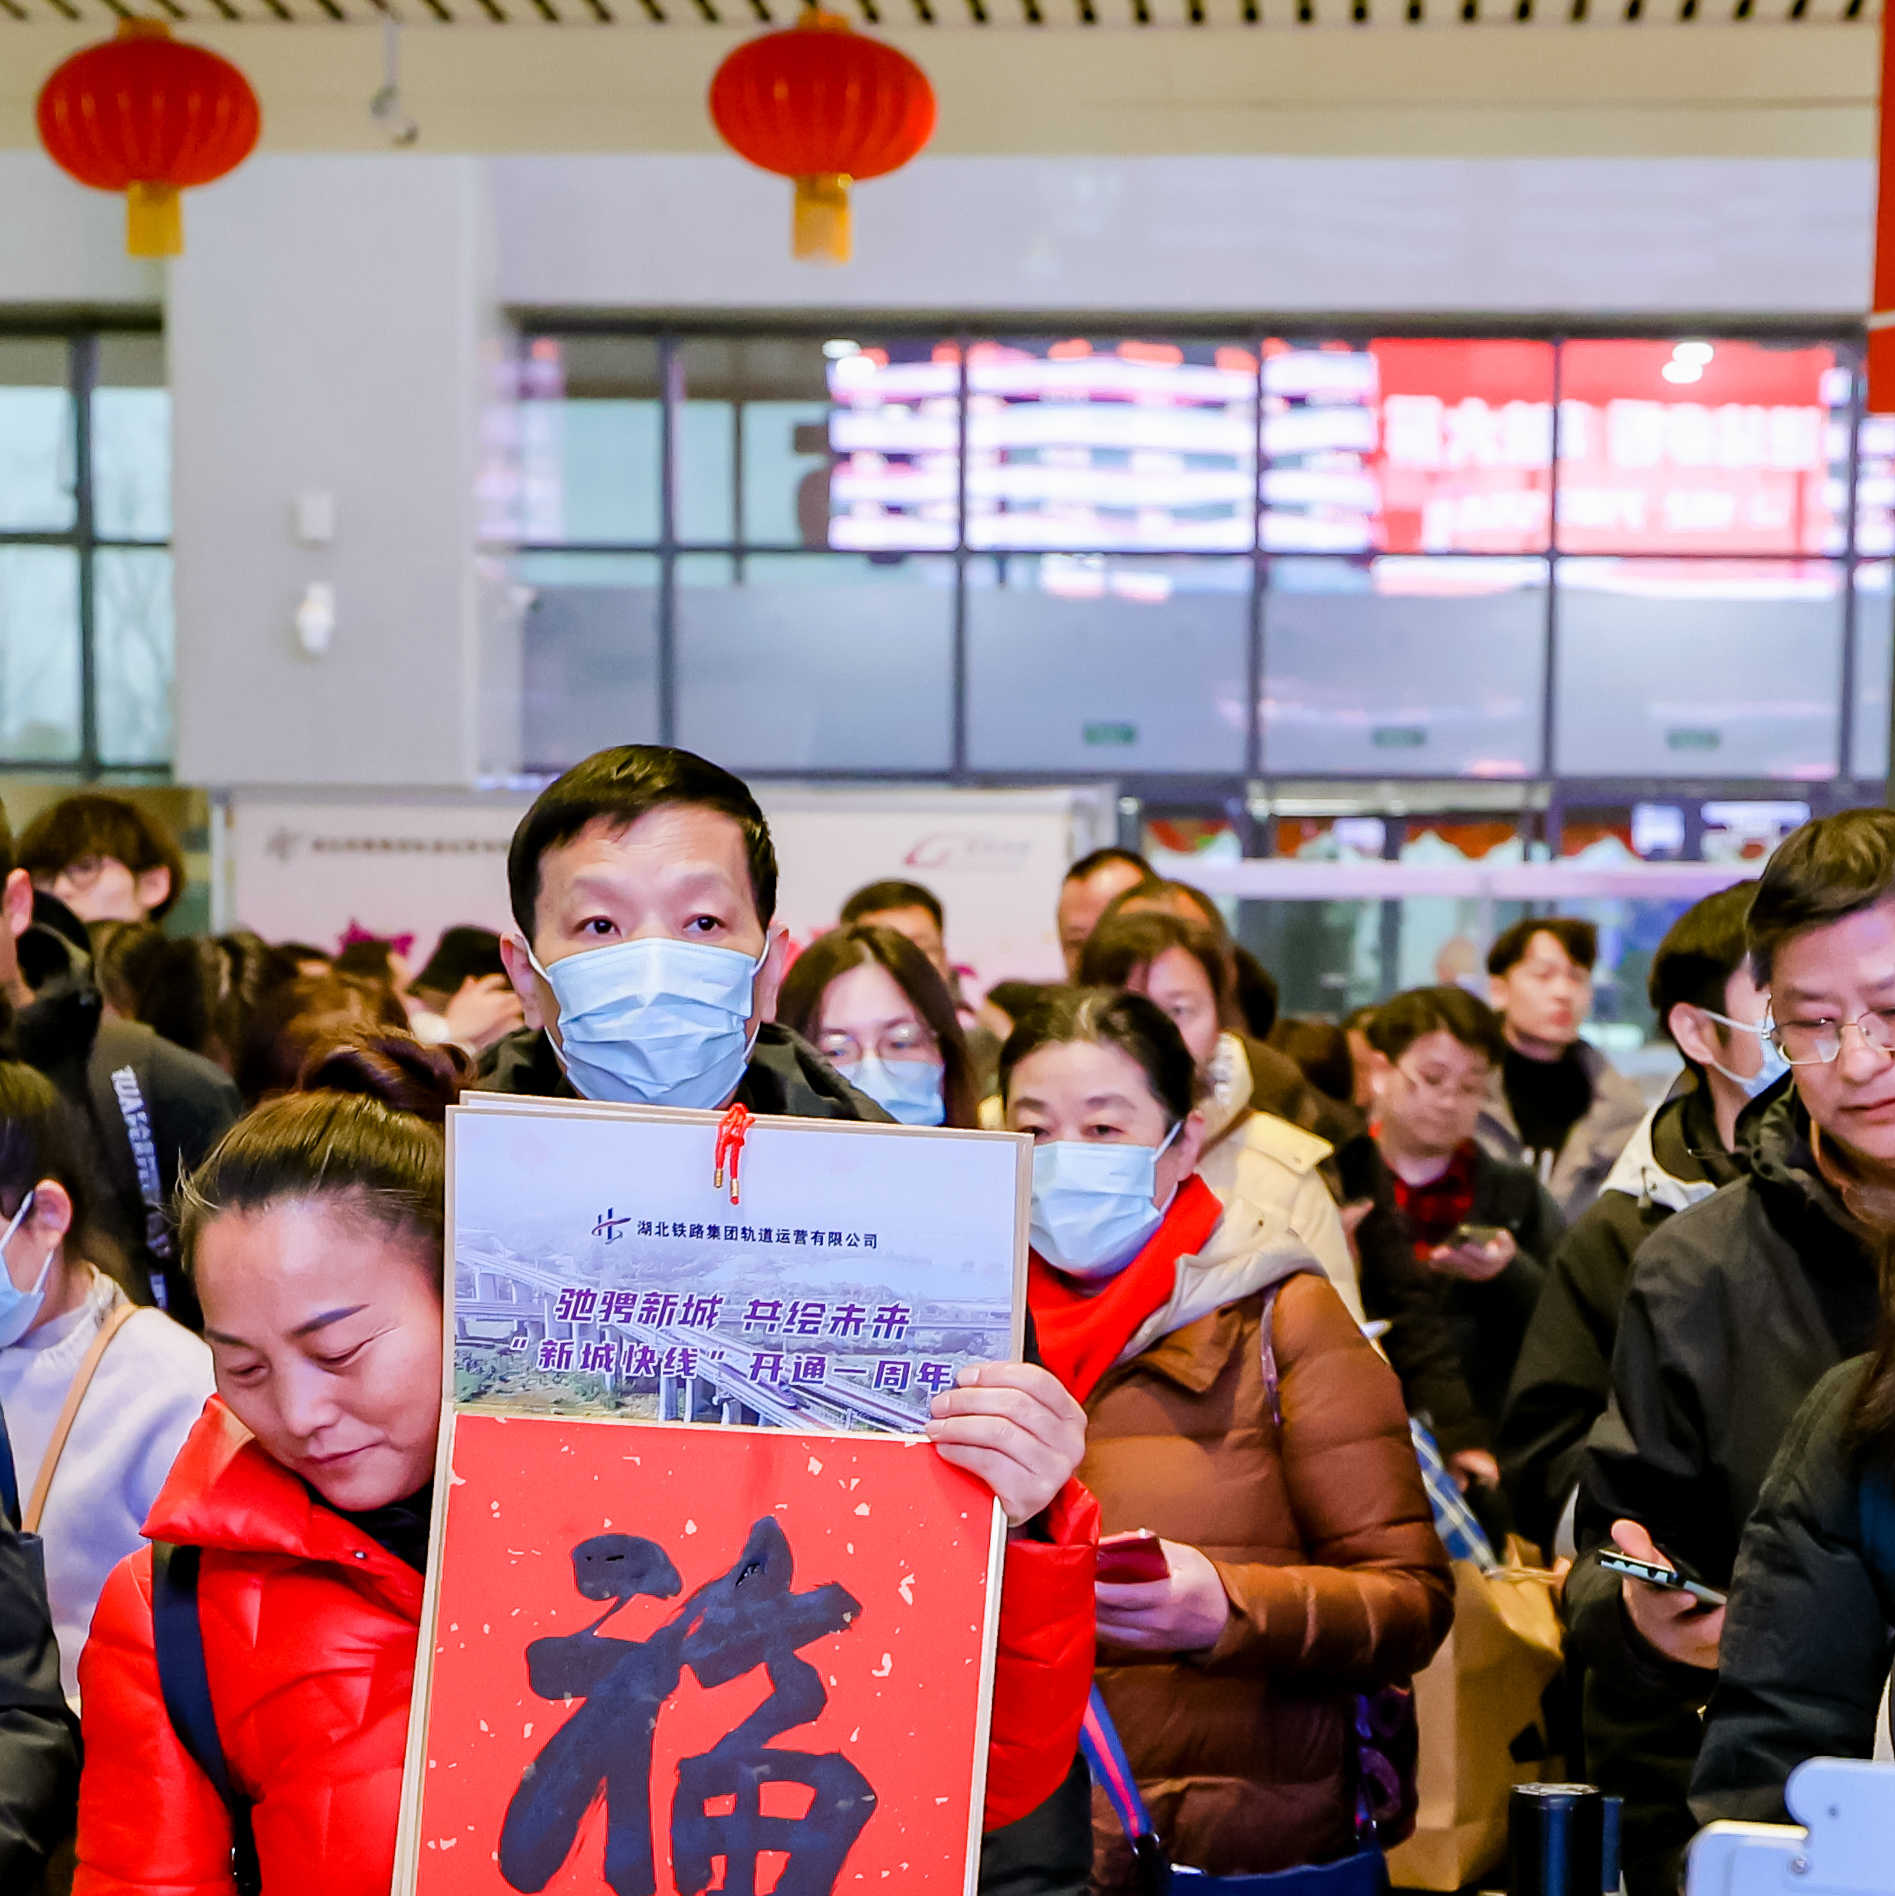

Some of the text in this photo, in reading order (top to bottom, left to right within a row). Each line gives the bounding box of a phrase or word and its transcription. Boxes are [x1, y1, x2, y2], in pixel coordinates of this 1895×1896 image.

[637, 1219, 879, 1250] 湖北铁路集团轨道运营有限公司
[553, 1286, 913, 1341] 驰骋新城 共绘未来
